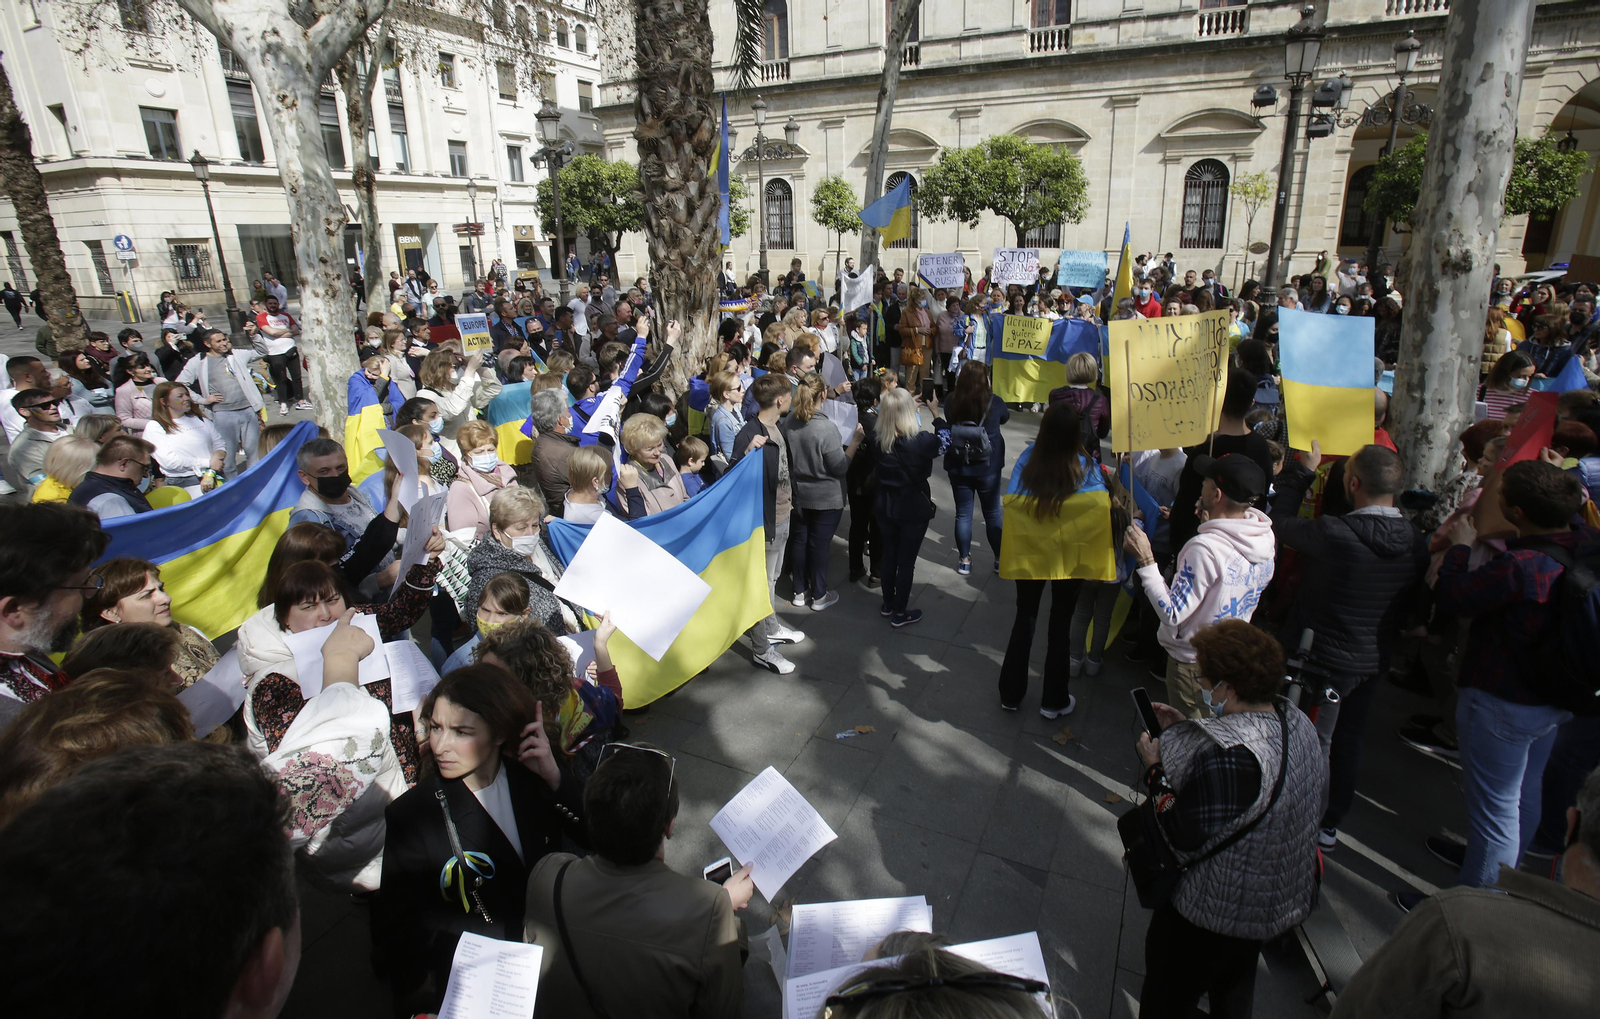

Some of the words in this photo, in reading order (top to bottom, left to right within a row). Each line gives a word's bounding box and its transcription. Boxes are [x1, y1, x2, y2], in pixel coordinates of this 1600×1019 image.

[920, 256, 958, 265] DETENER
[999, 251, 1033, 262] STOP
[925, 268, 935, 276] LA
[994, 262, 1028, 272] RUSSIAN
[935, 277, 957, 285] RUSA
[462, 321, 486, 330] EUROPE
[1007, 316, 1043, 330] Ucrania
[1011, 328, 1036, 340] quiere
[468, 337, 480, 347] ACT
[1017, 339, 1043, 350] PAZ
